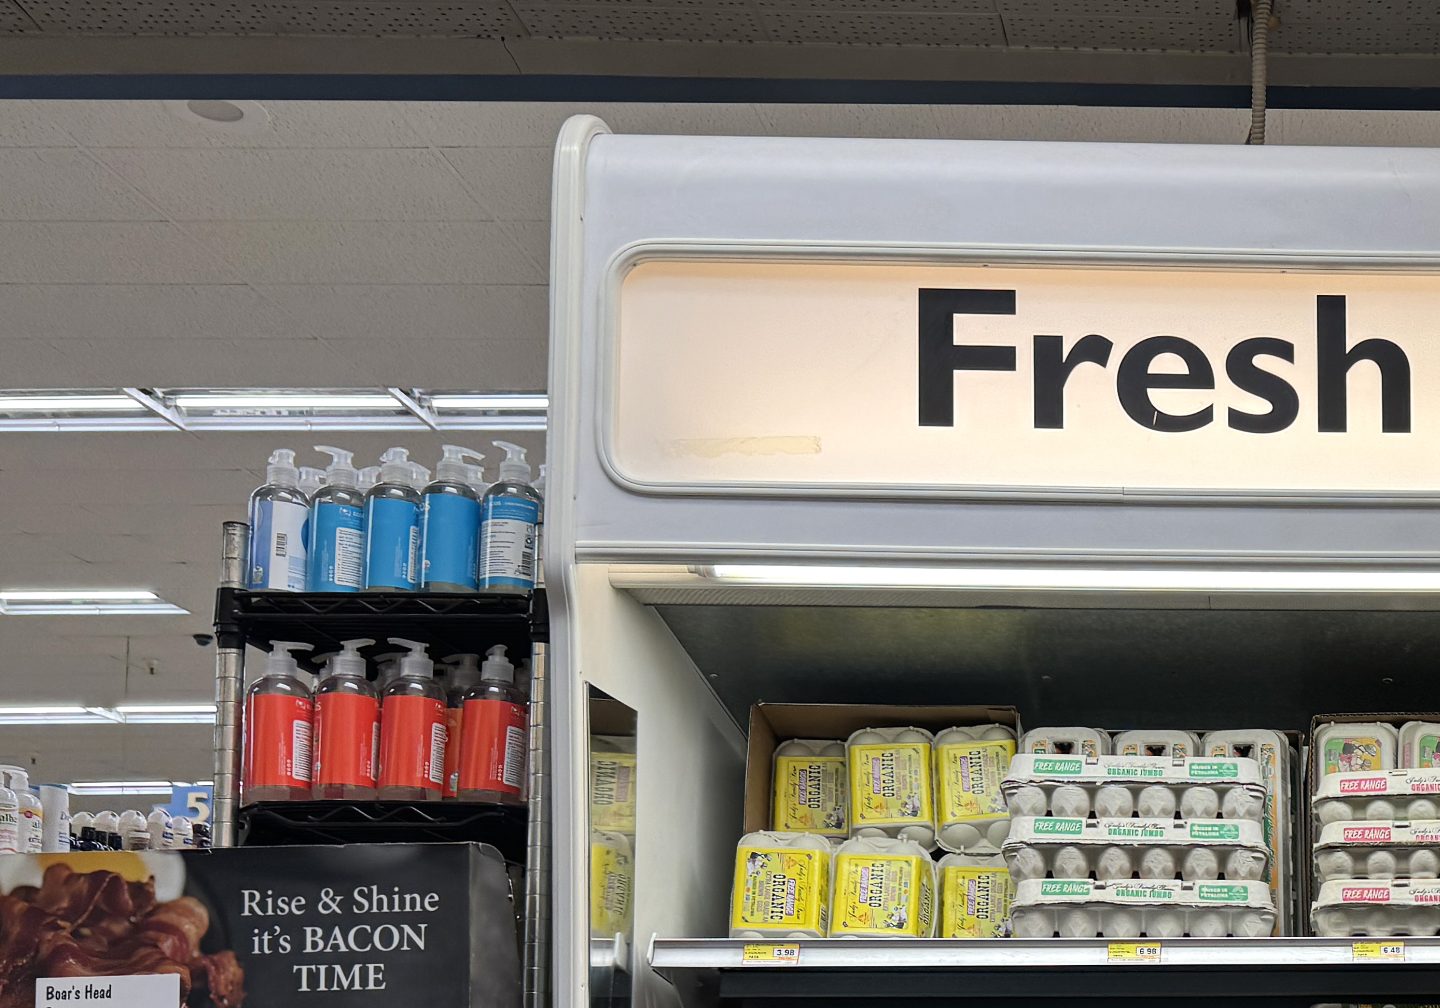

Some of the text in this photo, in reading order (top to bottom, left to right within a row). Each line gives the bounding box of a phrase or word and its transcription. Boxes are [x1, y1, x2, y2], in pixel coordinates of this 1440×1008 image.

[918, 288, 1411, 434] Fresh
[882, 752, 894, 797] ORGANIC
[1034, 761, 1081, 772] FREE RANGE
[1107, 768, 1163, 776] ORGANIC JUMBO
[1341, 779, 1386, 790] FREE RANGE
[188, 792, 210, 824] 5
[1035, 821, 1082, 831] FREE RANGE
[869, 863, 883, 907] ORGANIC
[241, 885, 439, 916] Rise & Shine
[252, 924, 428, 954] it's BACON
[293, 963, 386, 992] TIME
[46, 985, 112, 1000] Boar's Head
